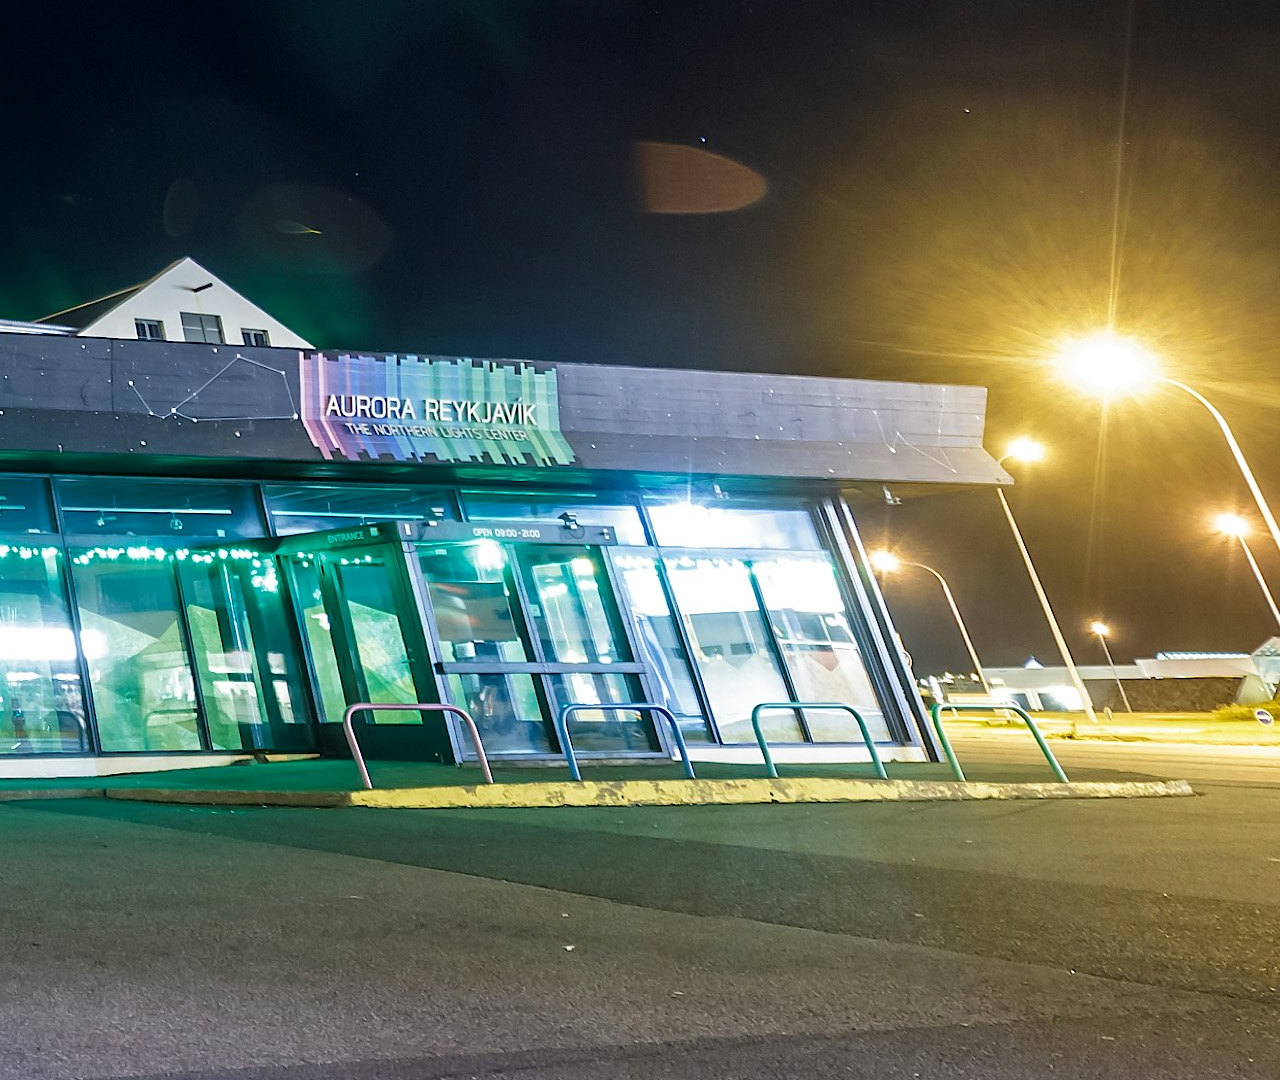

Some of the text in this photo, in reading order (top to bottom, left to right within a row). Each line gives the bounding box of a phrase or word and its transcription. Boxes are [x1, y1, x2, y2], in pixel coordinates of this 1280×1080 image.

[326, 394, 538, 425] AURORA REYKJAVÍK
[345, 422, 530, 441] THE NORTHERN LIGHTS CENTER
[327, 531, 365, 543] ENTRANCE
[472, 527, 493, 537] OPEN
